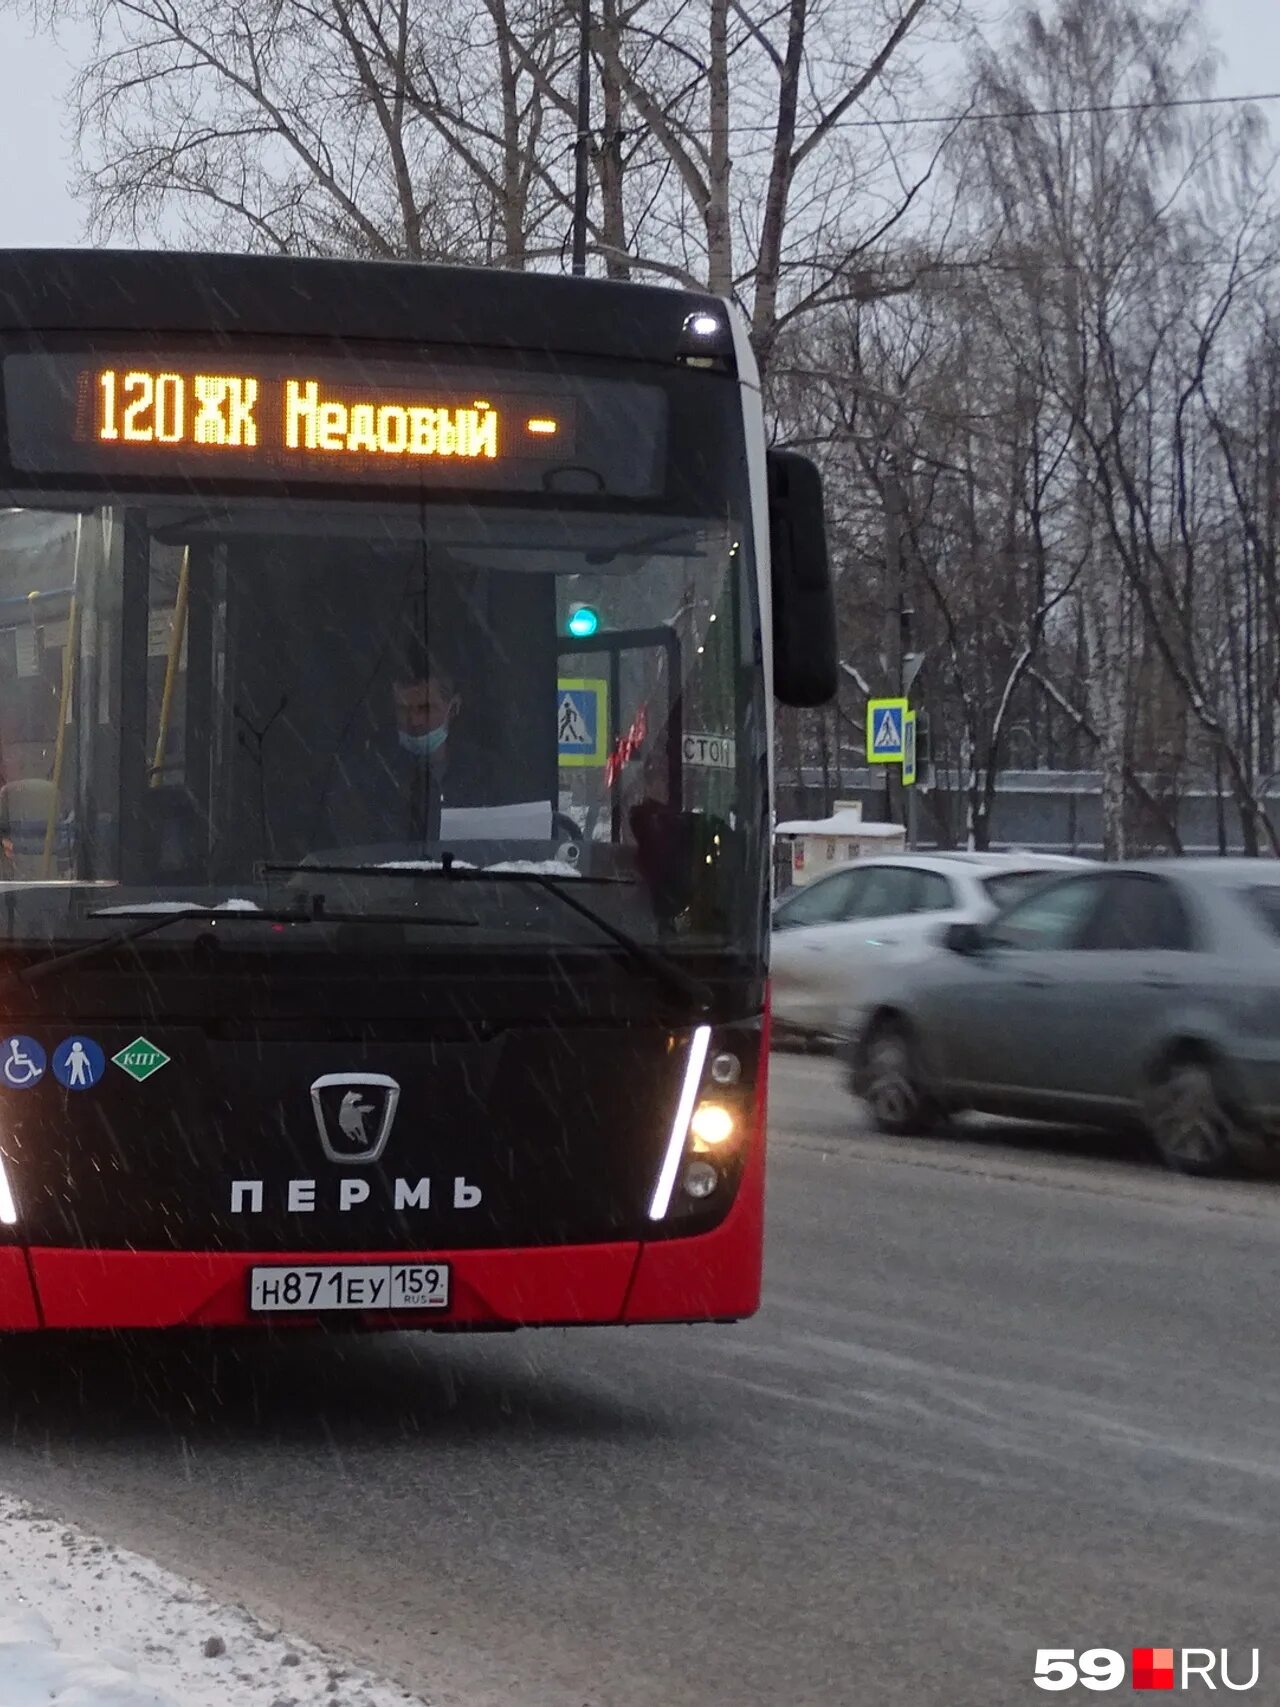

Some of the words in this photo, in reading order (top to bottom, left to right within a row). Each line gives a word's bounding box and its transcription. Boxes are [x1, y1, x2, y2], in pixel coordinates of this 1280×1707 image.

[99, 369, 183, 443] 120
[195, 375, 258, 446] ЖК
[123, 1052, 160, 1066] КПГ
[230, 1176, 483, 1213] ПЕРМЬ
[262, 1271, 385, 1306] Н871ЕУ
[394, 1268, 440, 1294] 159
[404, 1294, 427, 1305] RUS
